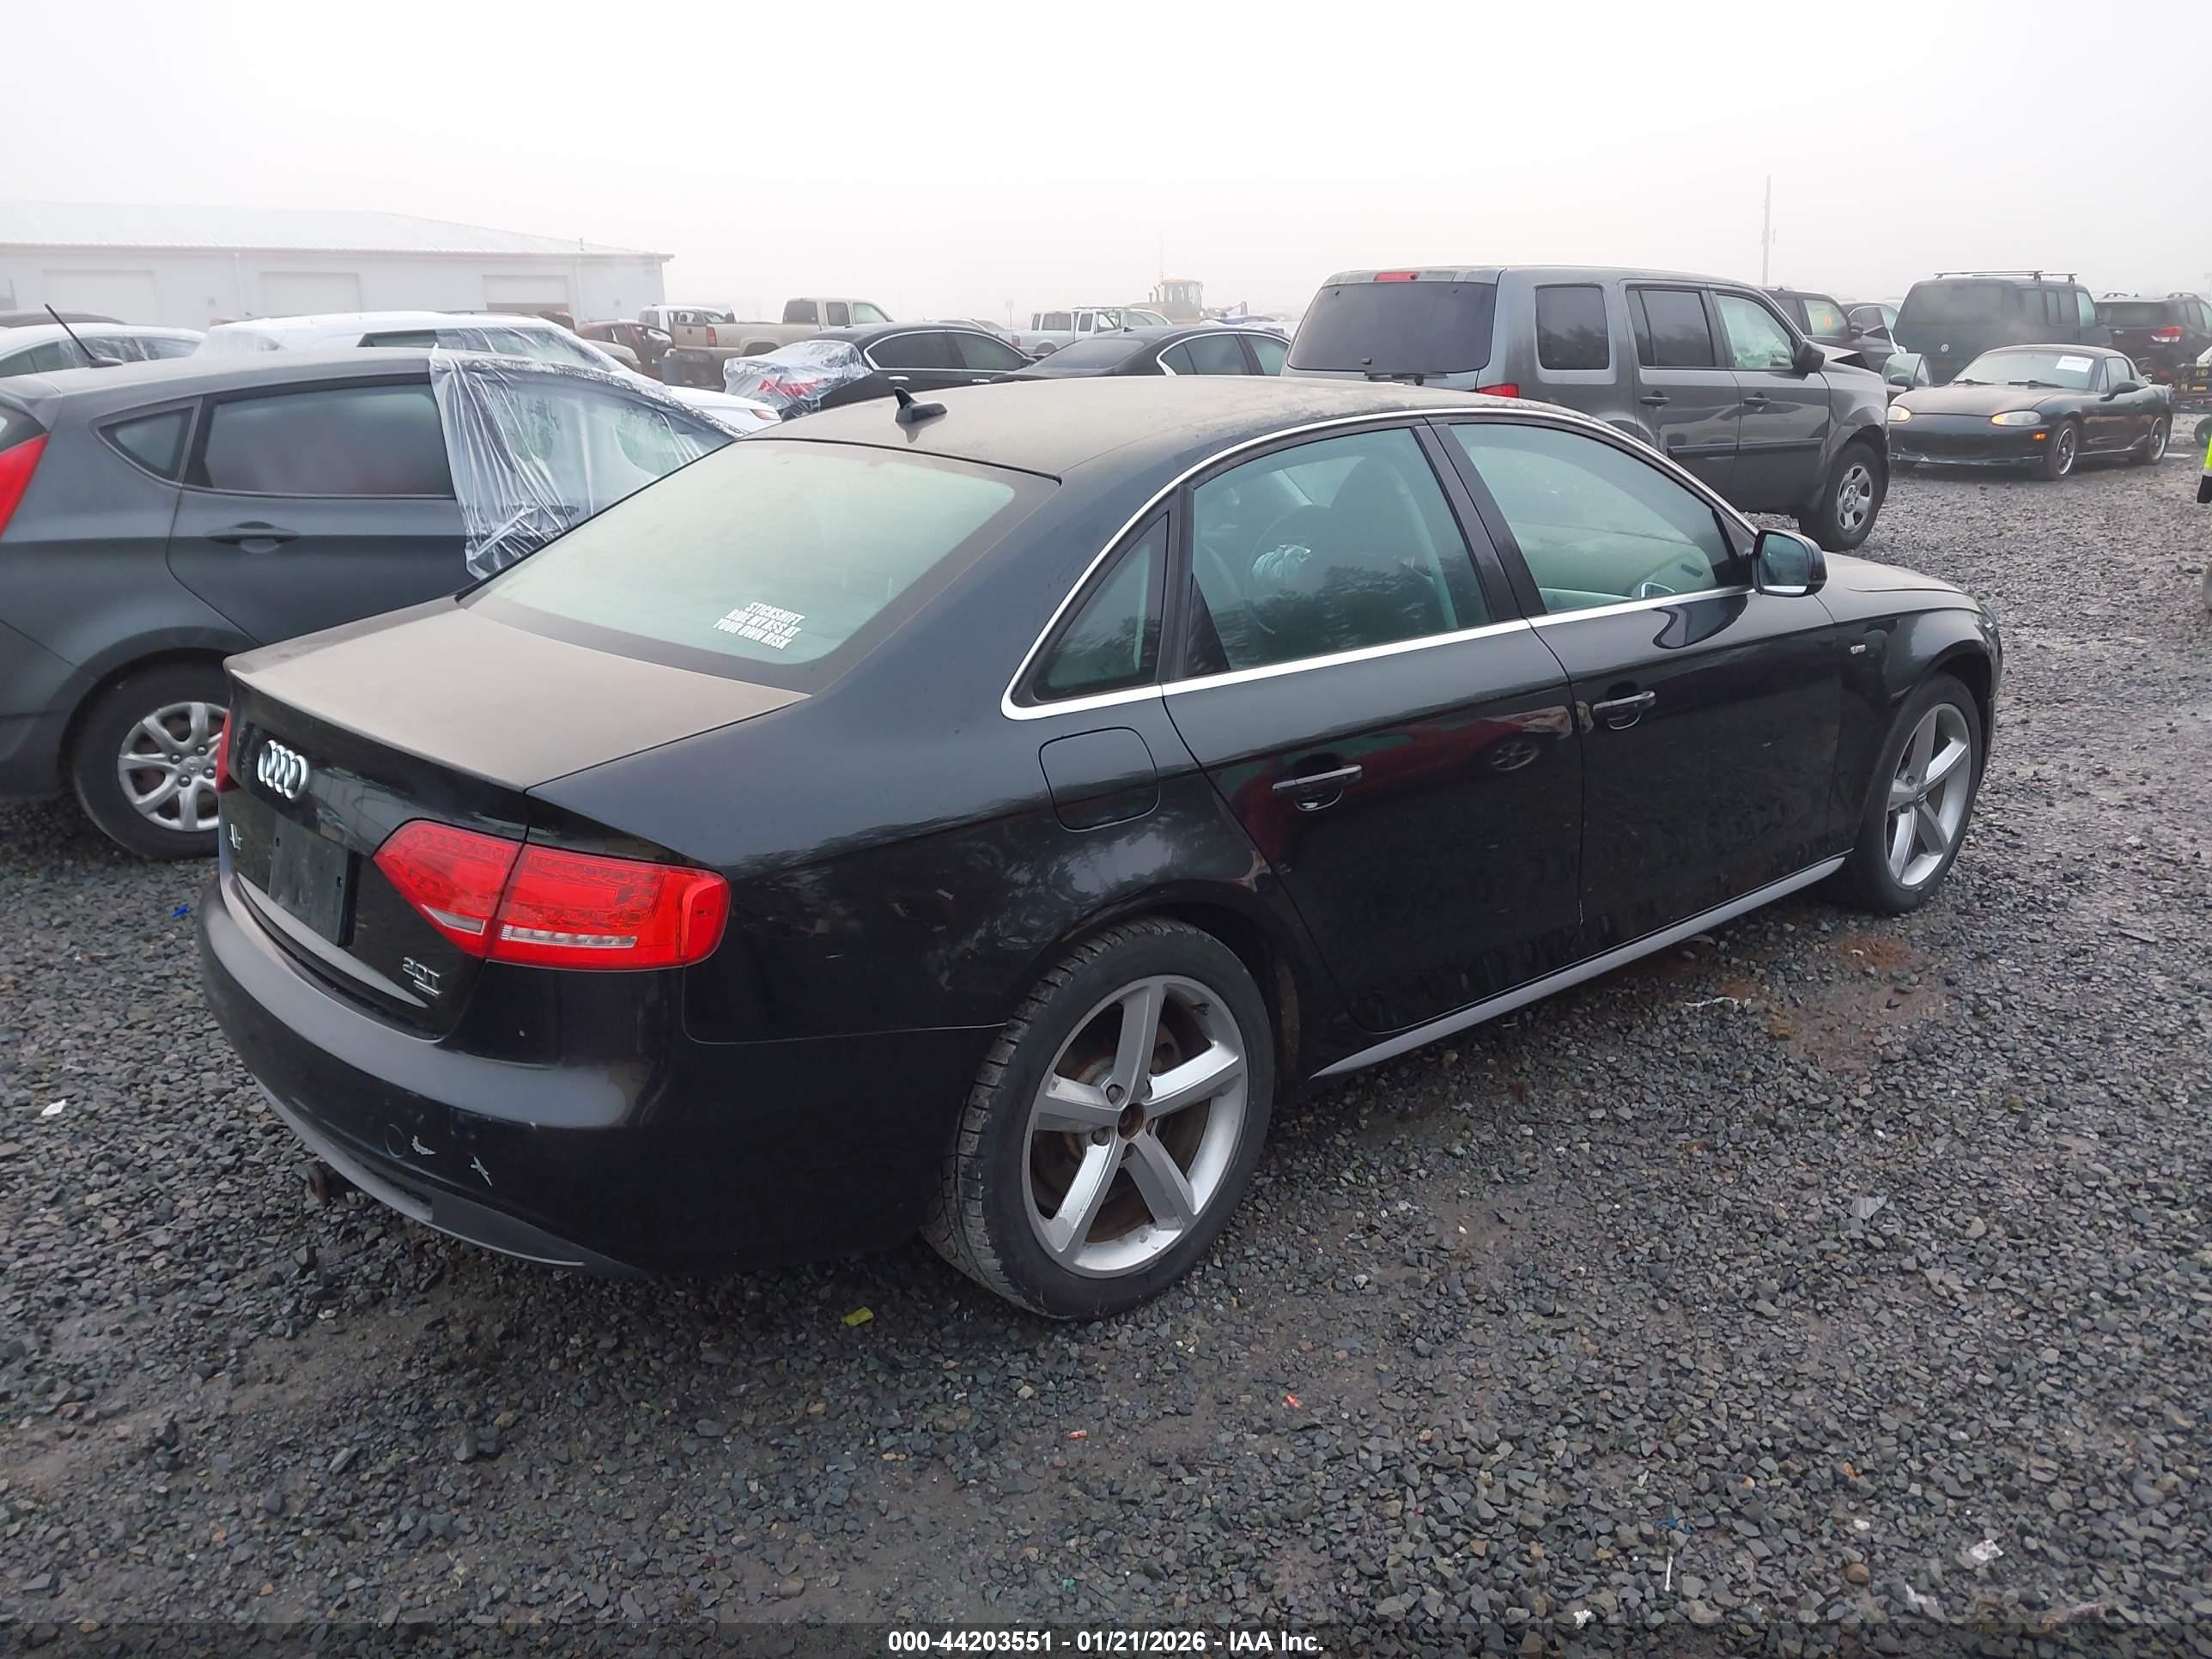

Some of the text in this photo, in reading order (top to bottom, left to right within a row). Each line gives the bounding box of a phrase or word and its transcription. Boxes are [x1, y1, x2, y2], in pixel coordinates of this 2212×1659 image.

[726, 609, 802, 638] RIDE MY ASS AT
[744, 601, 805, 626] STICKSHIFT
[713, 617, 793, 650] YOUR OWN RISK
